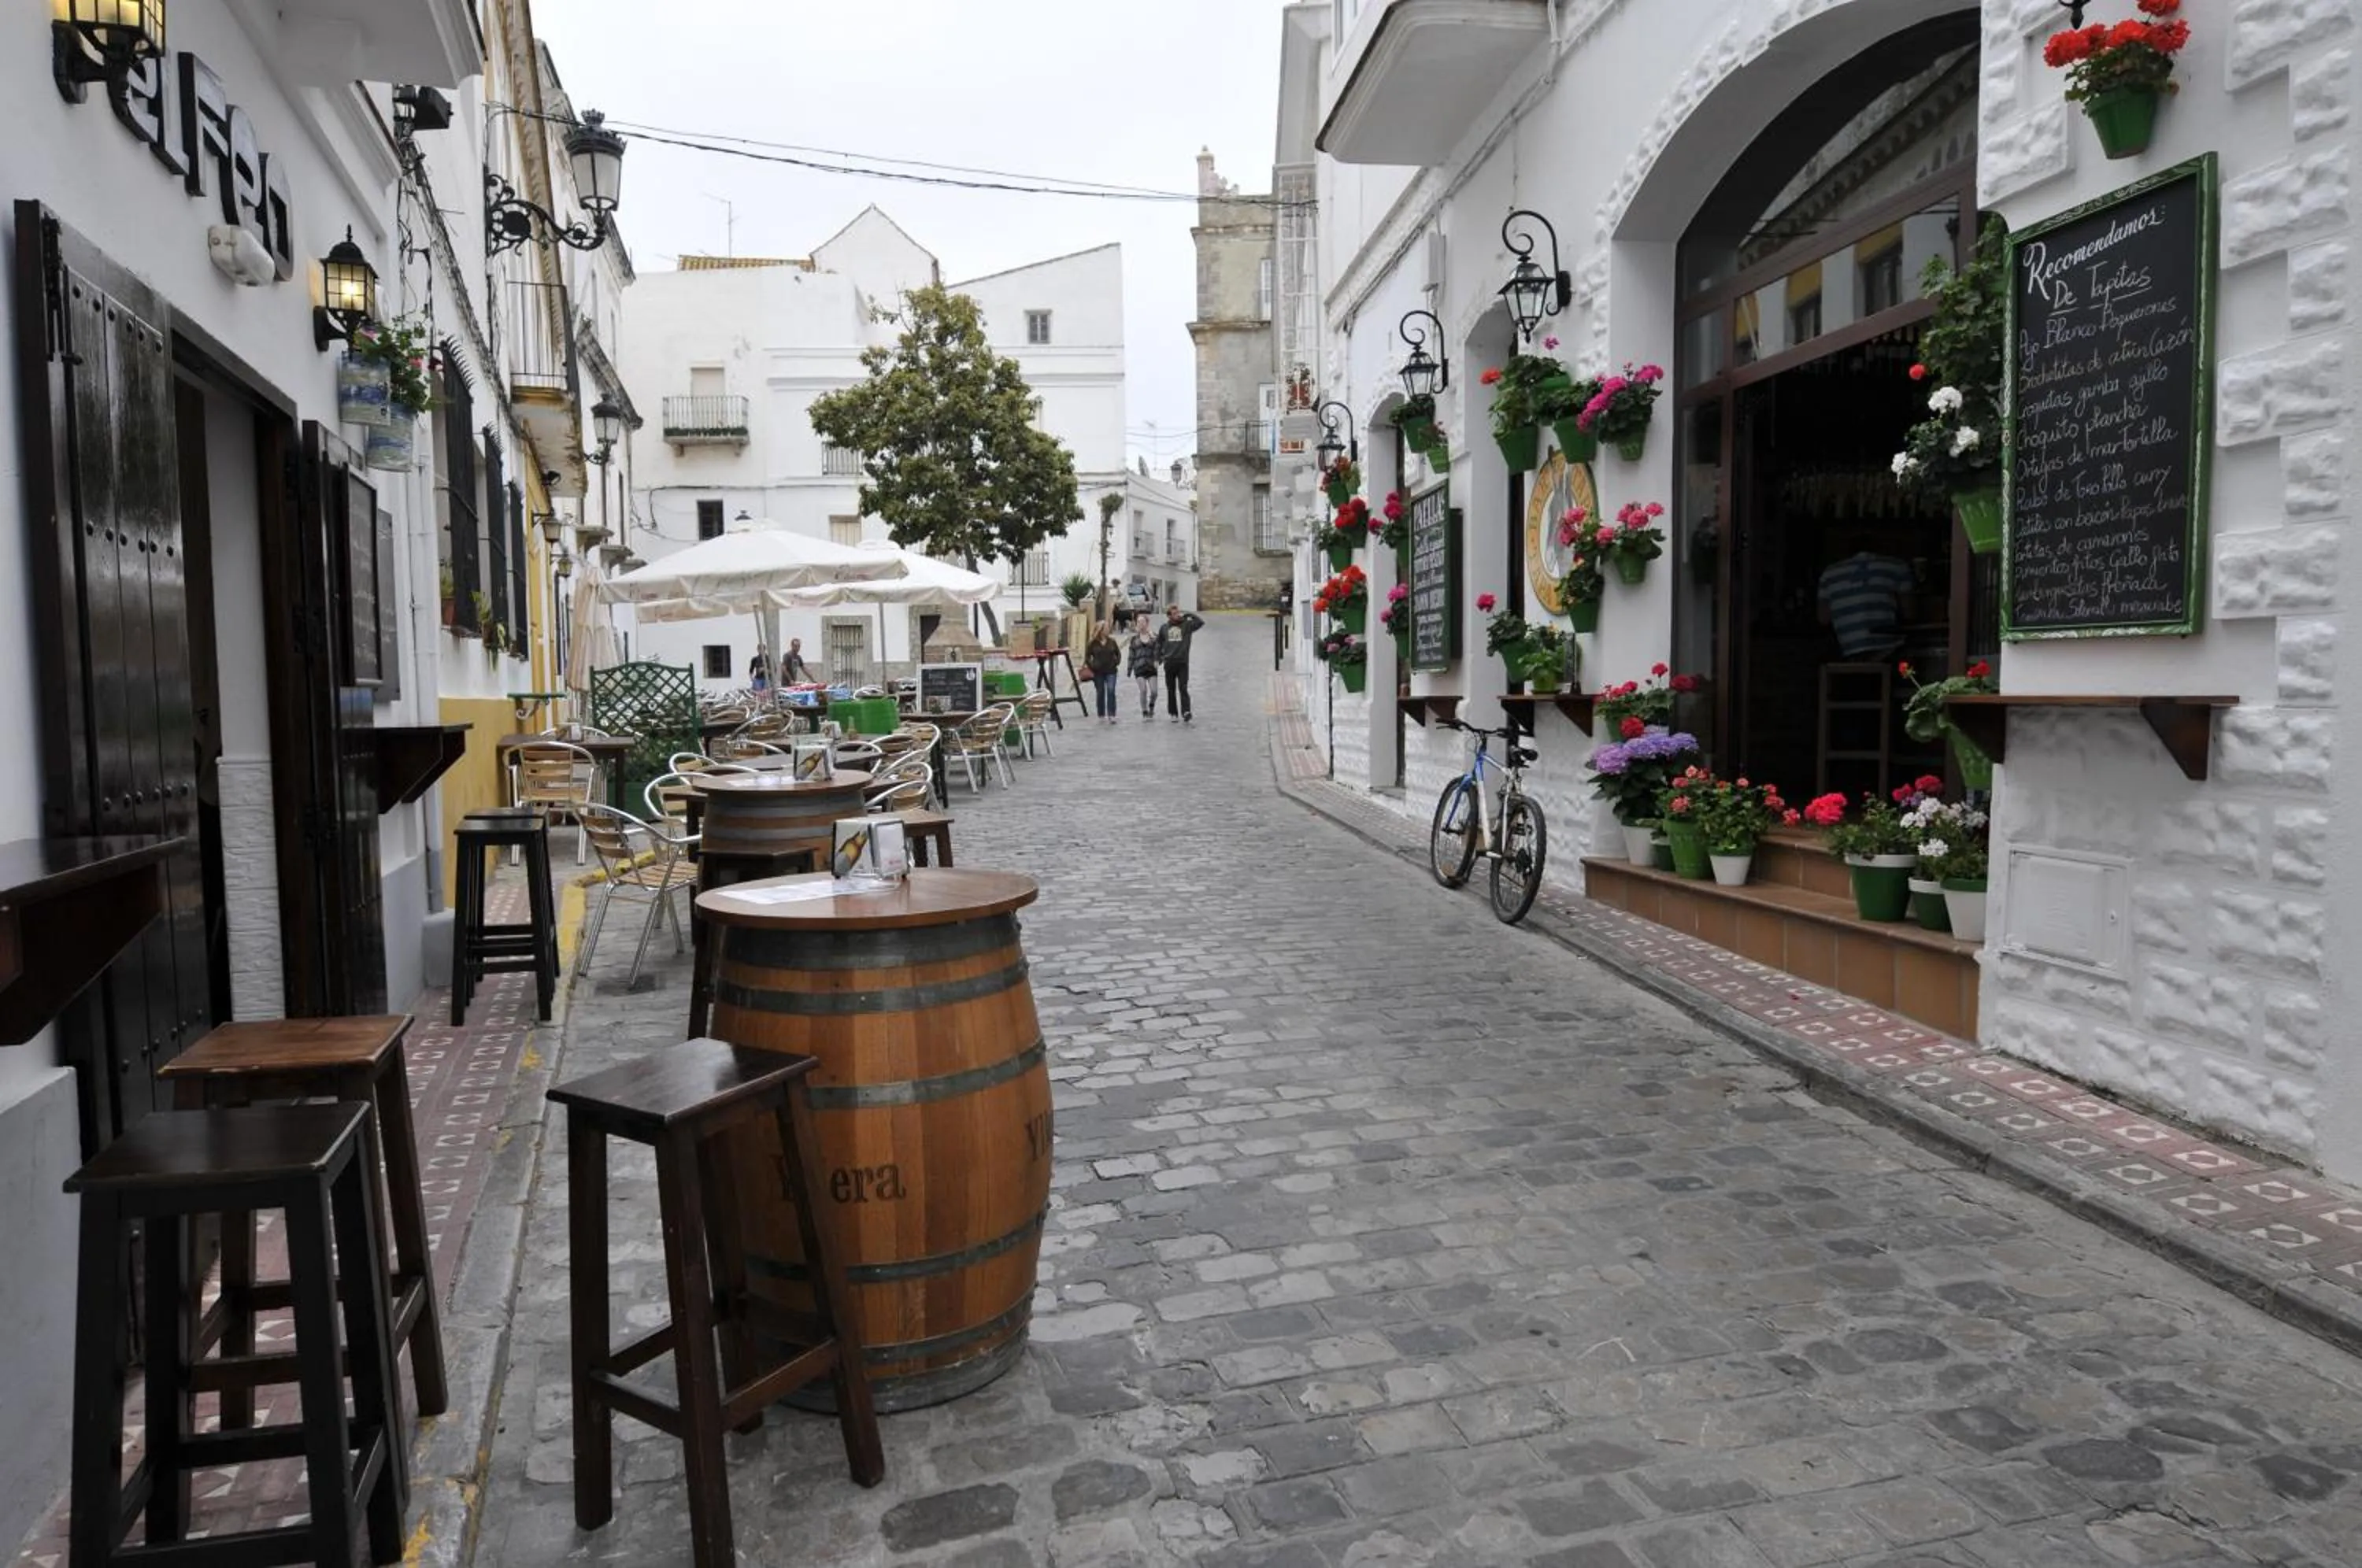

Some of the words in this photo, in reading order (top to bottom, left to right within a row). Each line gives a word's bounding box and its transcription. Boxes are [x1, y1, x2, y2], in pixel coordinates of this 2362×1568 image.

[2053, 279, 2078, 309] De
[2086, 261, 2152, 304] Tapitas
[2043, 316, 2096, 349] Blanco
